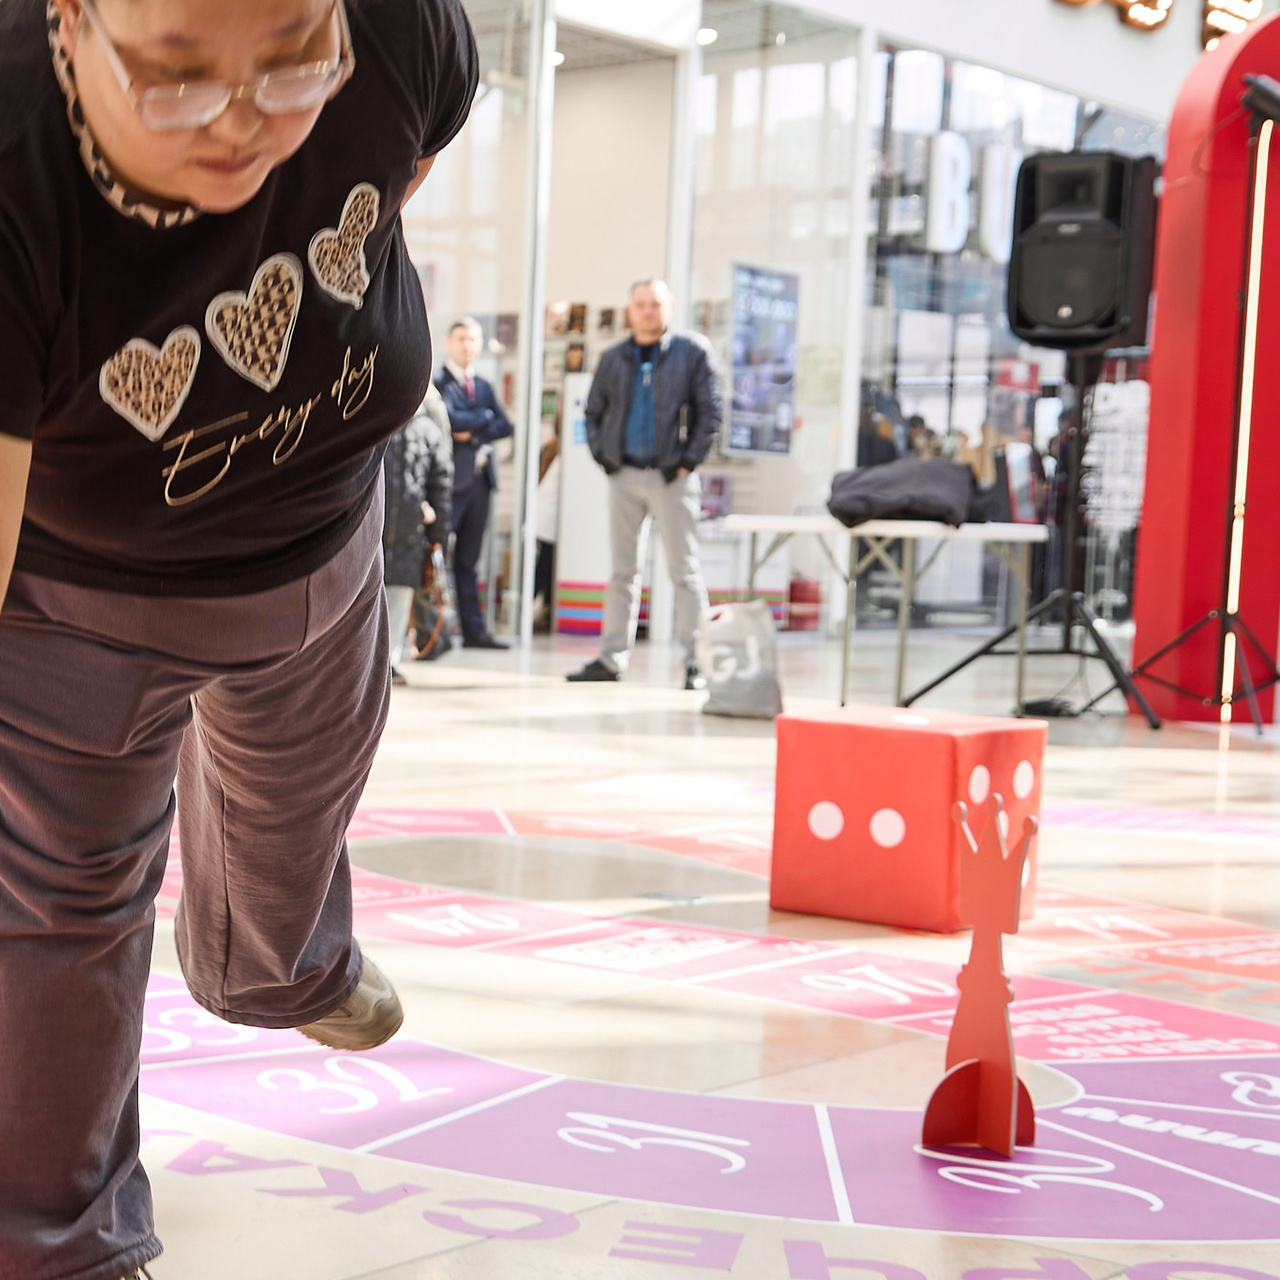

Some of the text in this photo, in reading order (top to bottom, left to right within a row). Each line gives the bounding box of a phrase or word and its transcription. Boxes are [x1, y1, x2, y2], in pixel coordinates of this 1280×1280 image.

[331, 343, 380, 421] day
[385, 903, 520, 938] 24
[800, 964, 959, 1004] 26
[1008, 1014, 1164, 1037] ШАГО
[256, 1055, 454, 1114] 32
[556, 1111, 750, 1175] 31
[912, 1143, 1164, 1212] 30
